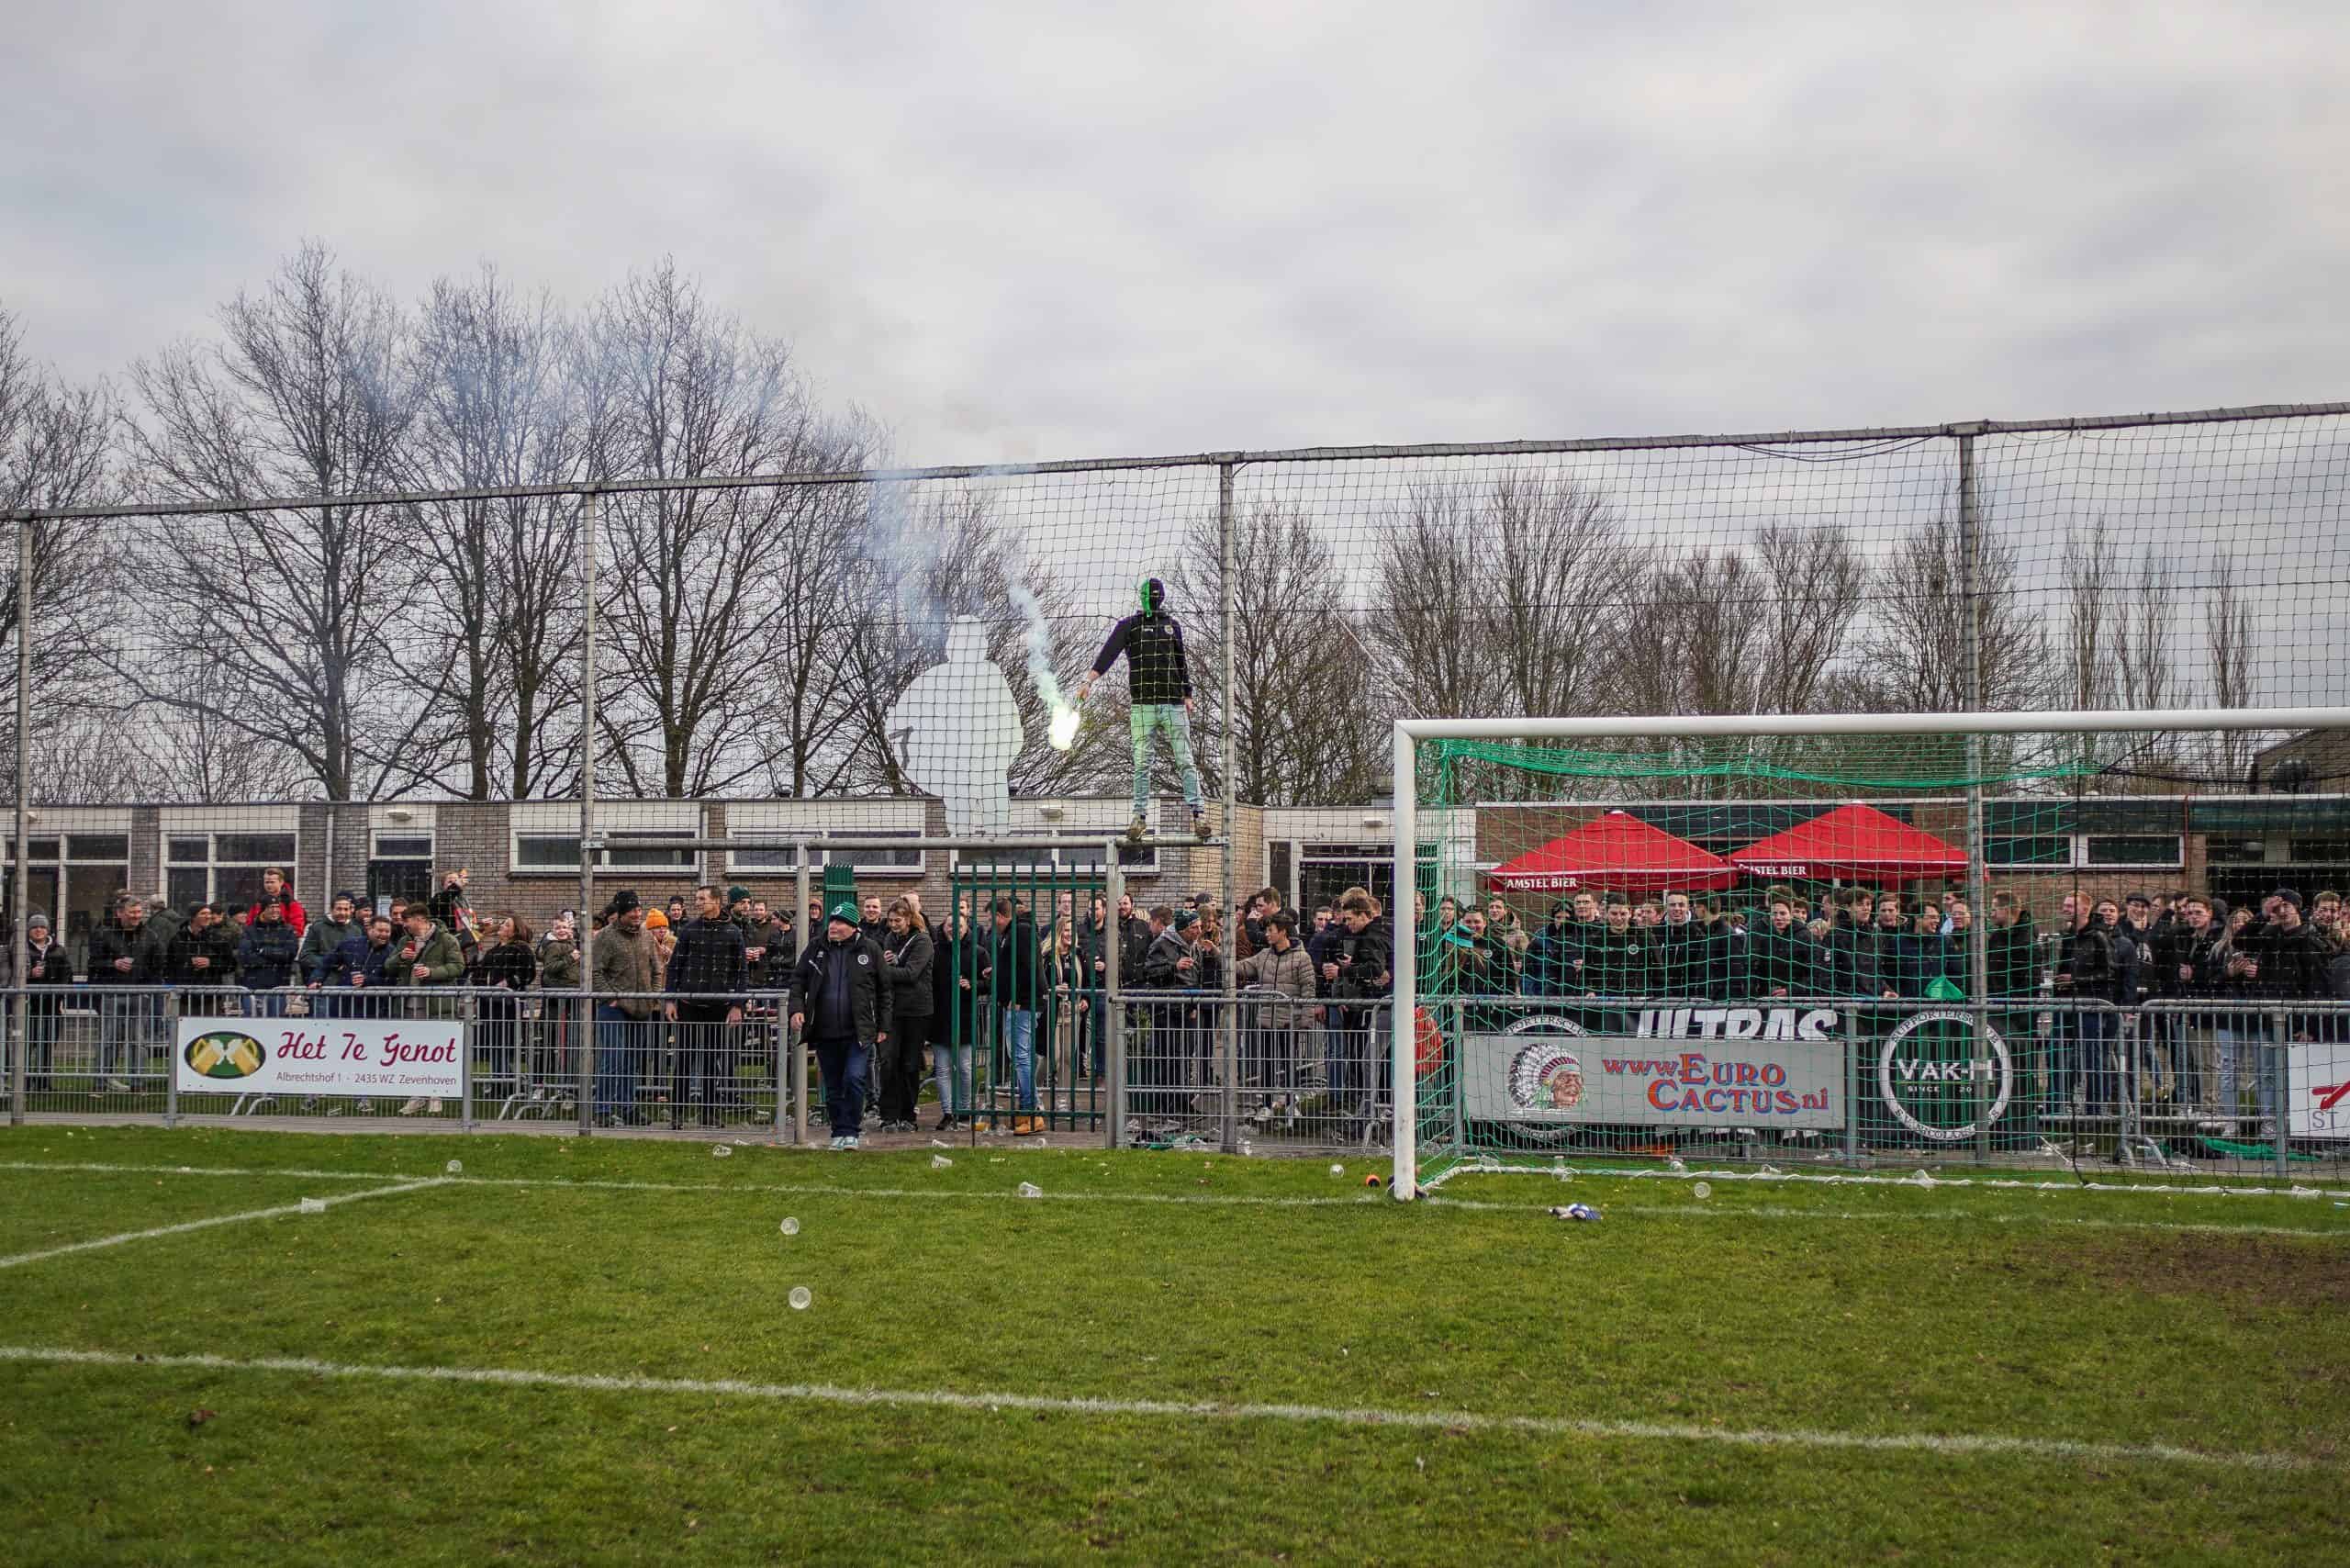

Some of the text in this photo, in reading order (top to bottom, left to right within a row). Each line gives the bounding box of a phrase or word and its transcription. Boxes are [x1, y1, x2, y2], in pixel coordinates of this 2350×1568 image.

[1781, 866, 1807, 875] BIER
[1506, 877, 1577, 889] AMSTEL BIER
[277, 1031, 457, 1067] Het 7e Genot
[1897, 1058, 1992, 1081] VAK-H
[275, 1071, 334, 1085] Albrechtshof
[354, 1074, 376, 1084] 2435
[379, 1075, 395, 1085] WZ
[398, 1074, 456, 1086] Zevenhoven
[1908, 1085, 1940, 1093] SINCE
